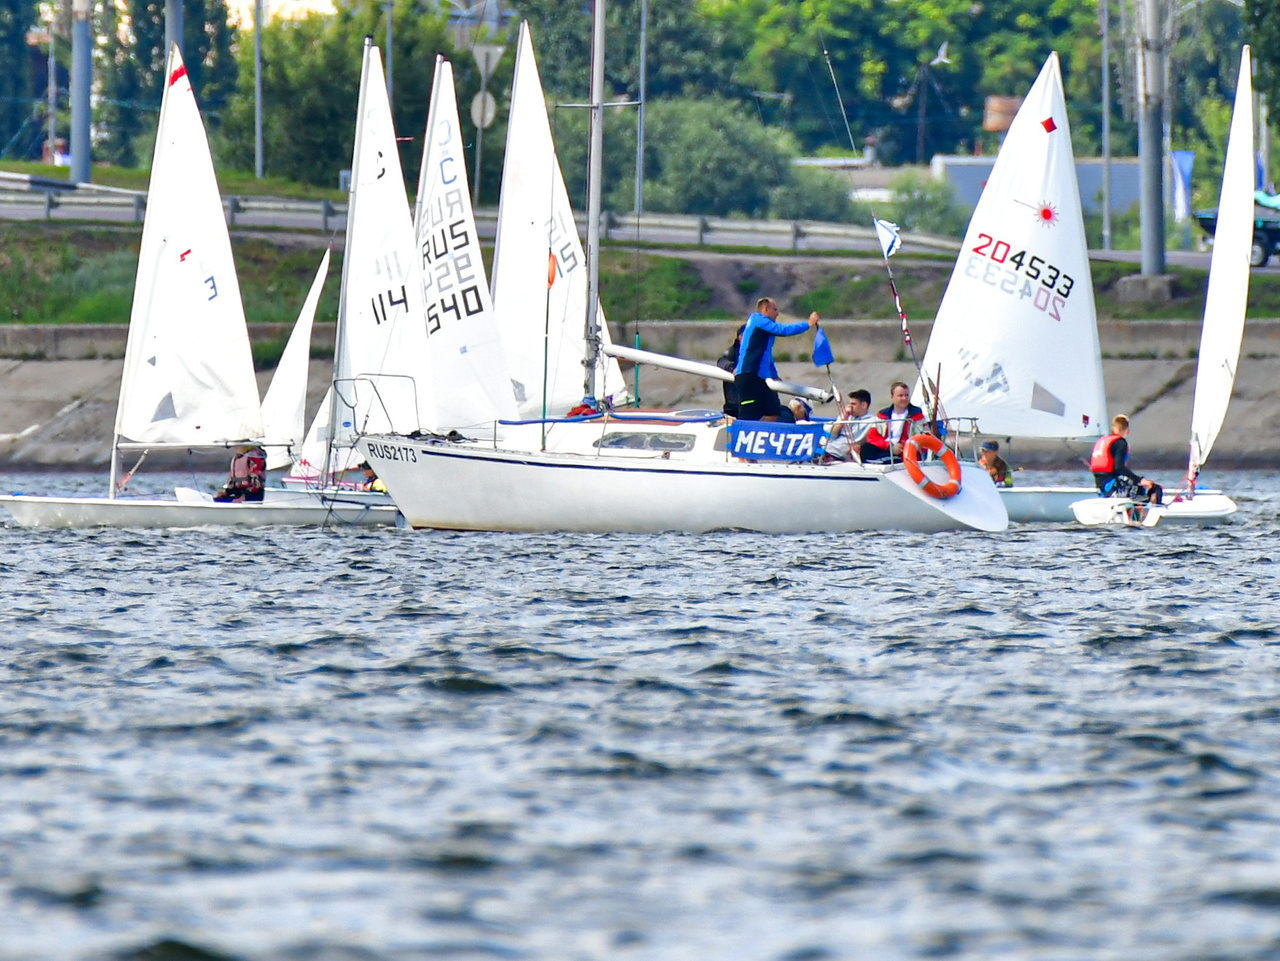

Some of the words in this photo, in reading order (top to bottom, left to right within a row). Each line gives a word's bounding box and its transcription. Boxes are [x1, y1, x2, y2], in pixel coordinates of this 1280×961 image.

[422, 219, 470, 271] RUS
[972, 233, 1075, 299] 204533
[204, 275, 218, 301] 3
[371, 285, 409, 325] 114
[367, 443, 418, 463] RUS2173
[734, 430, 815, 457] МЕЧТА
